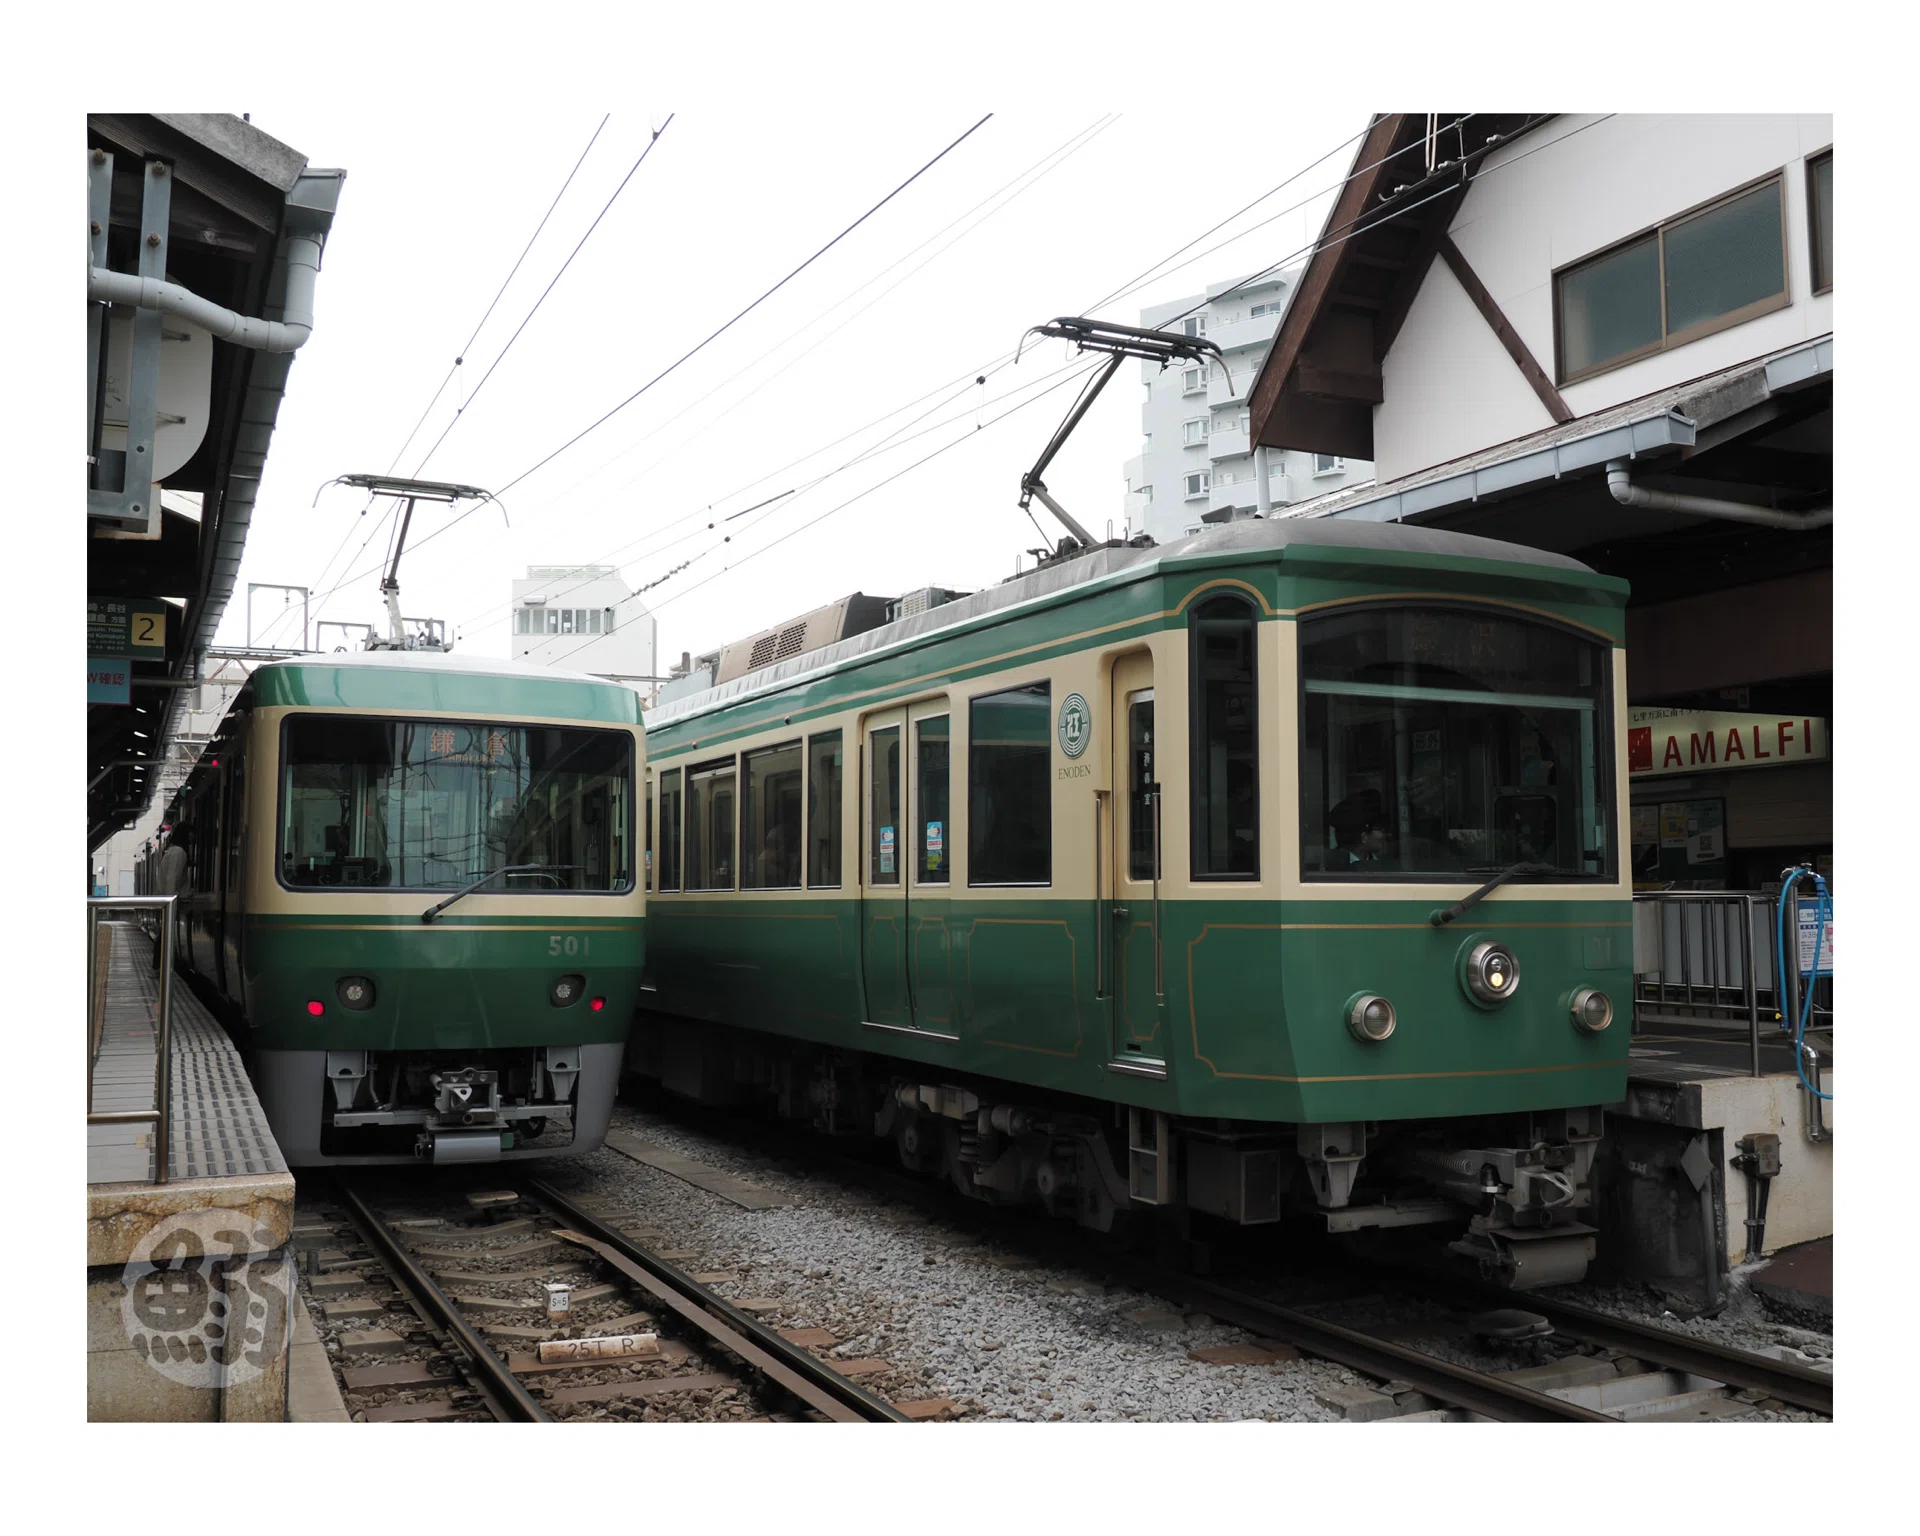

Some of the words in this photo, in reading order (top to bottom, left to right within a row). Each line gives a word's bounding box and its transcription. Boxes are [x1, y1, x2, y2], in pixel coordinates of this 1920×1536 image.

[138, 617, 155, 641] 2
[430, 728, 507, 757] 鎌倉
[1663, 719, 1812, 768] AMALFI
[1058, 764, 1091, 780] ENODEN
[548, 935, 590, 956] 501
[621, 1337, 635, 1354] R
